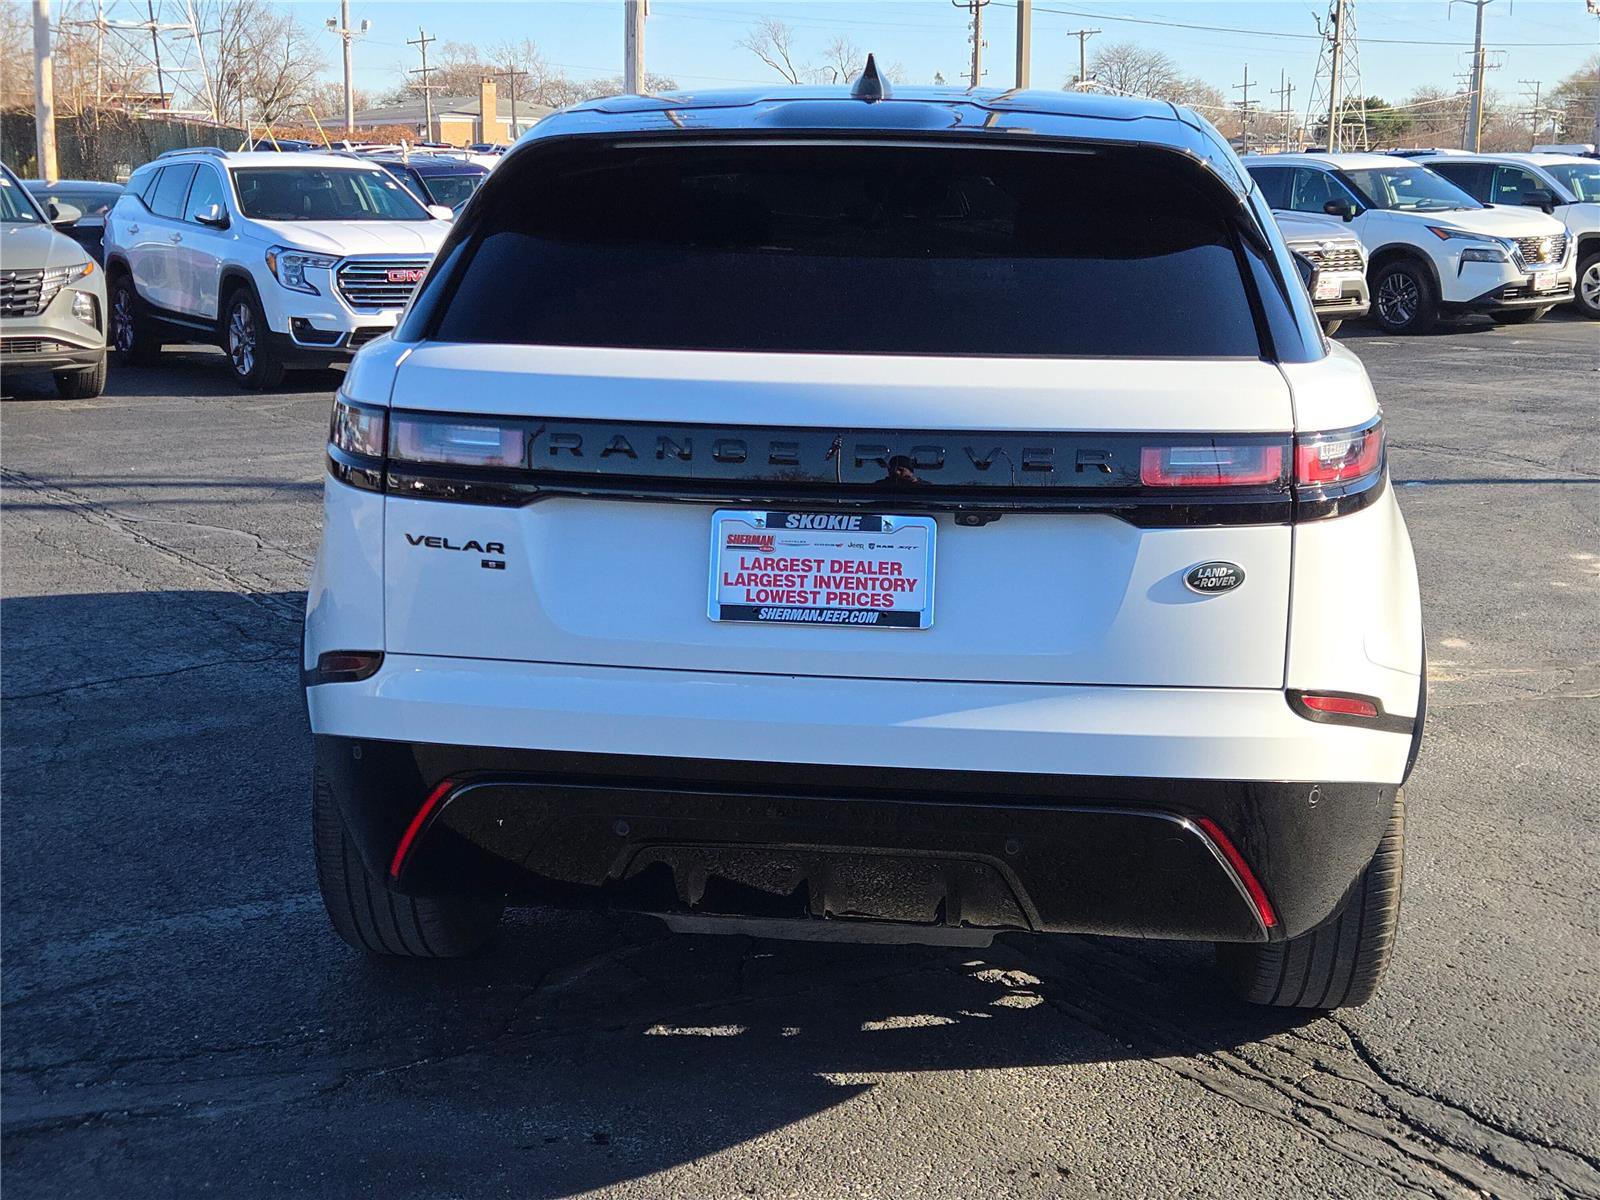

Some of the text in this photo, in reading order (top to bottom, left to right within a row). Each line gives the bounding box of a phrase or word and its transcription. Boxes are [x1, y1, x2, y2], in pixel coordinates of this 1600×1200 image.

[387, 269, 427, 282] GM
[549, 432, 1112, 473] RANGE ROVER
[785, 514, 862, 530] SKOKIE
[404, 533, 505, 554] VELAR
[726, 534, 775, 545] SHERMAN
[740, 557, 902, 576] LARGEST DEALER
[1198, 567, 1227, 578] LAND
[723, 572, 918, 593] LARGEST INVENTORY
[1200, 576, 1235, 588] ROVER
[745, 589, 894, 608] LOWEST PRICES
[758, 608, 879, 624] SHERMANJEEP.COM
